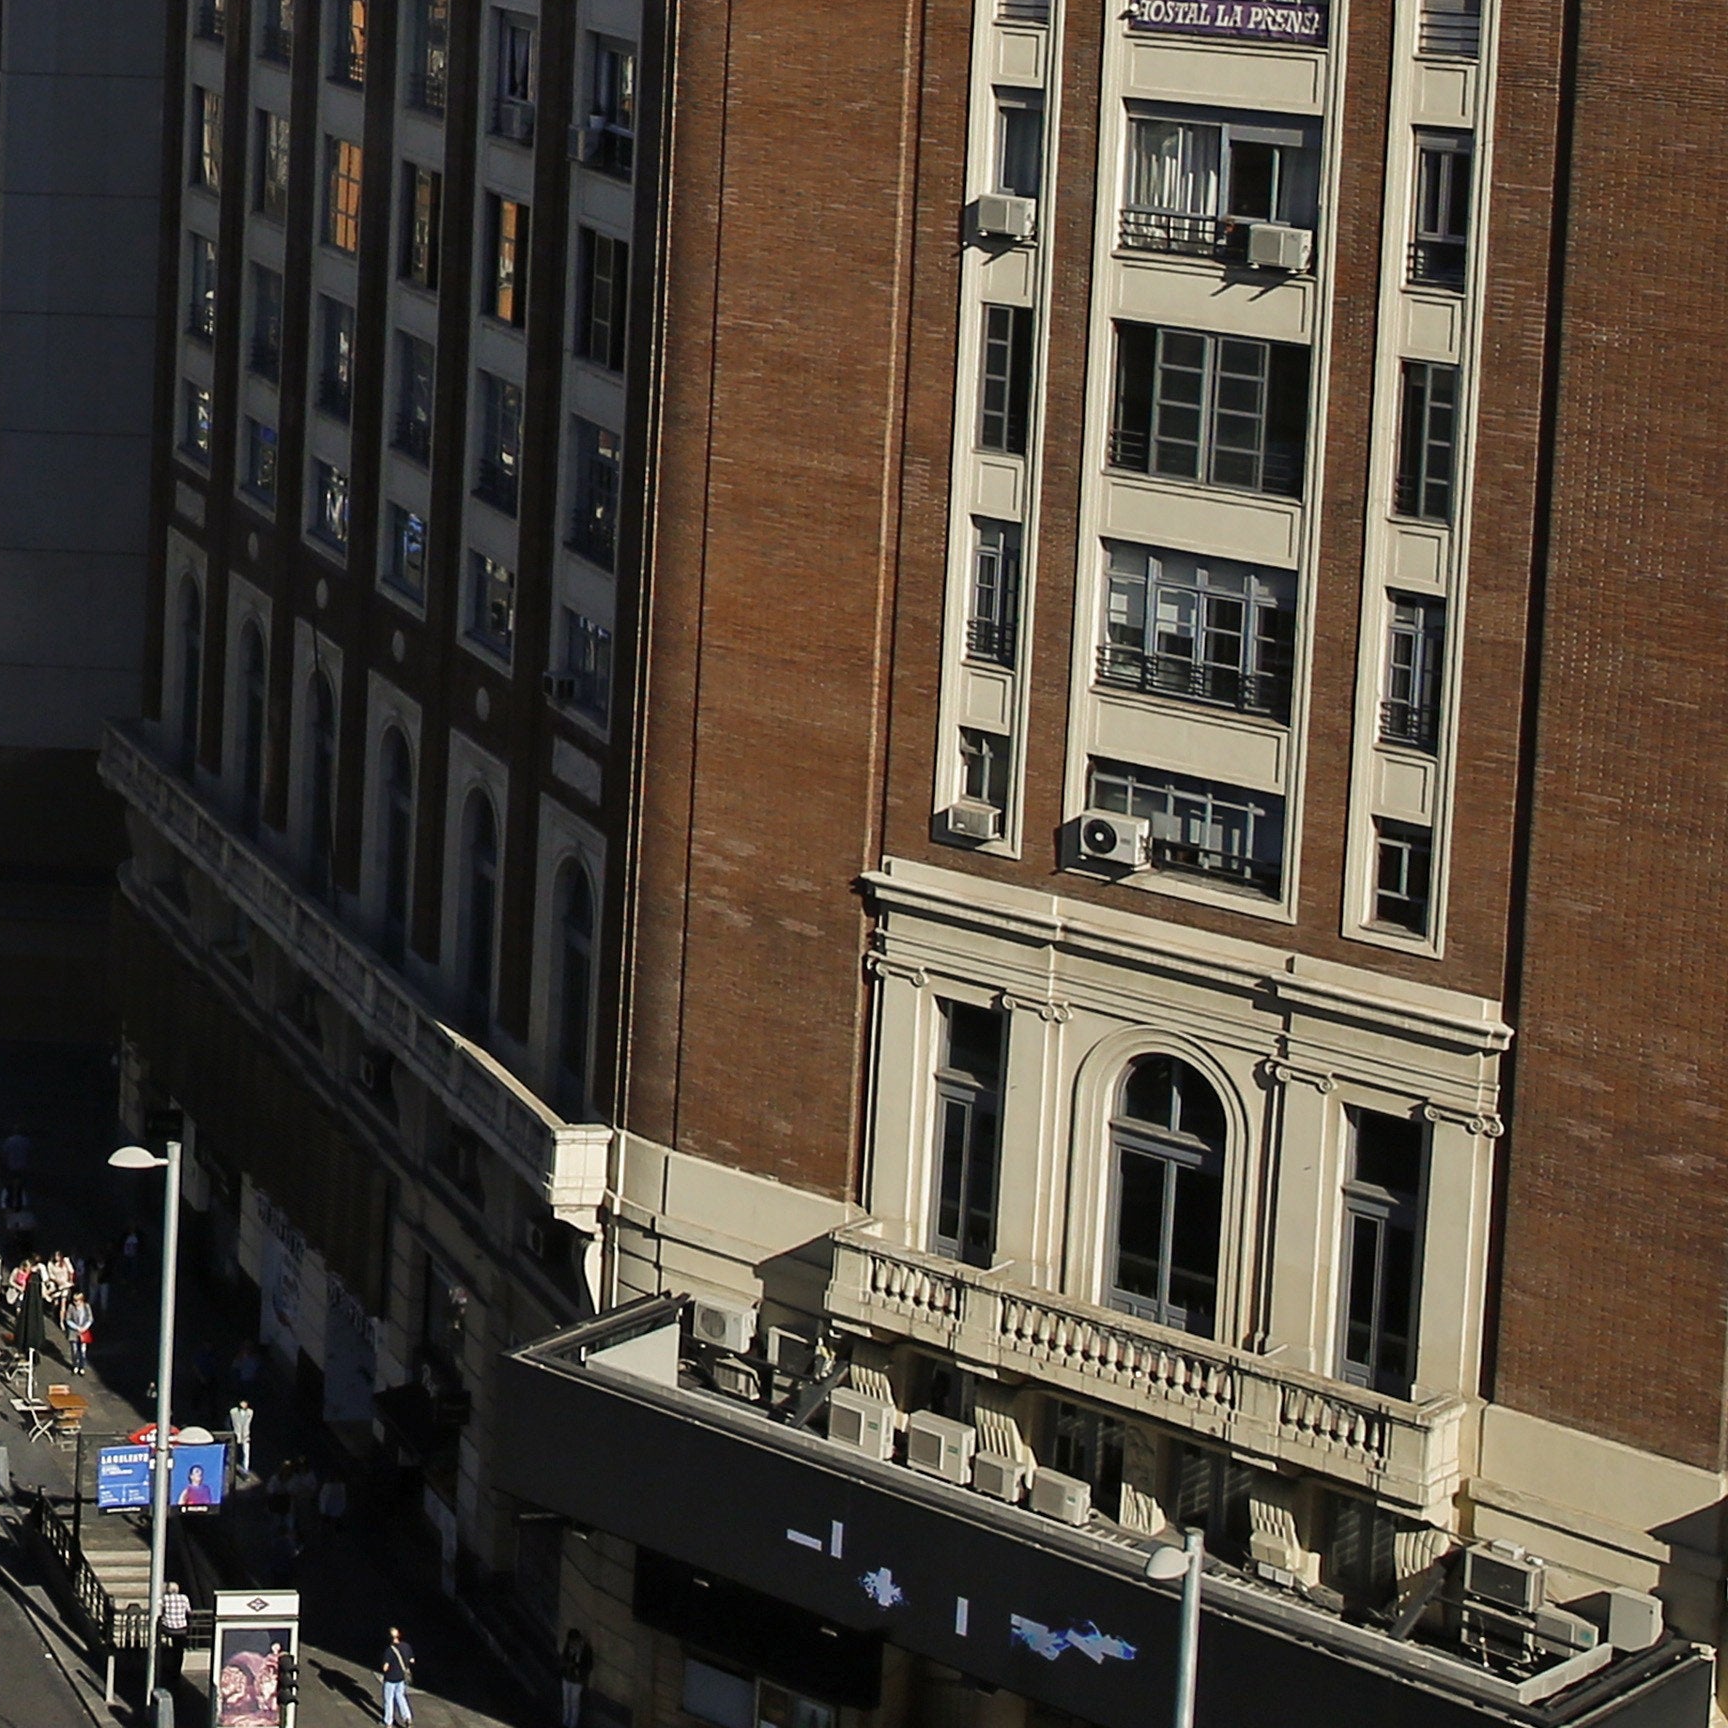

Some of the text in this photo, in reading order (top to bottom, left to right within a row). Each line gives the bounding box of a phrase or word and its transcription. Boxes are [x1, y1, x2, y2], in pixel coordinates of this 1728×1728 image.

[1137, 0, 1321, 35] HOSTAL LA PRENSA
